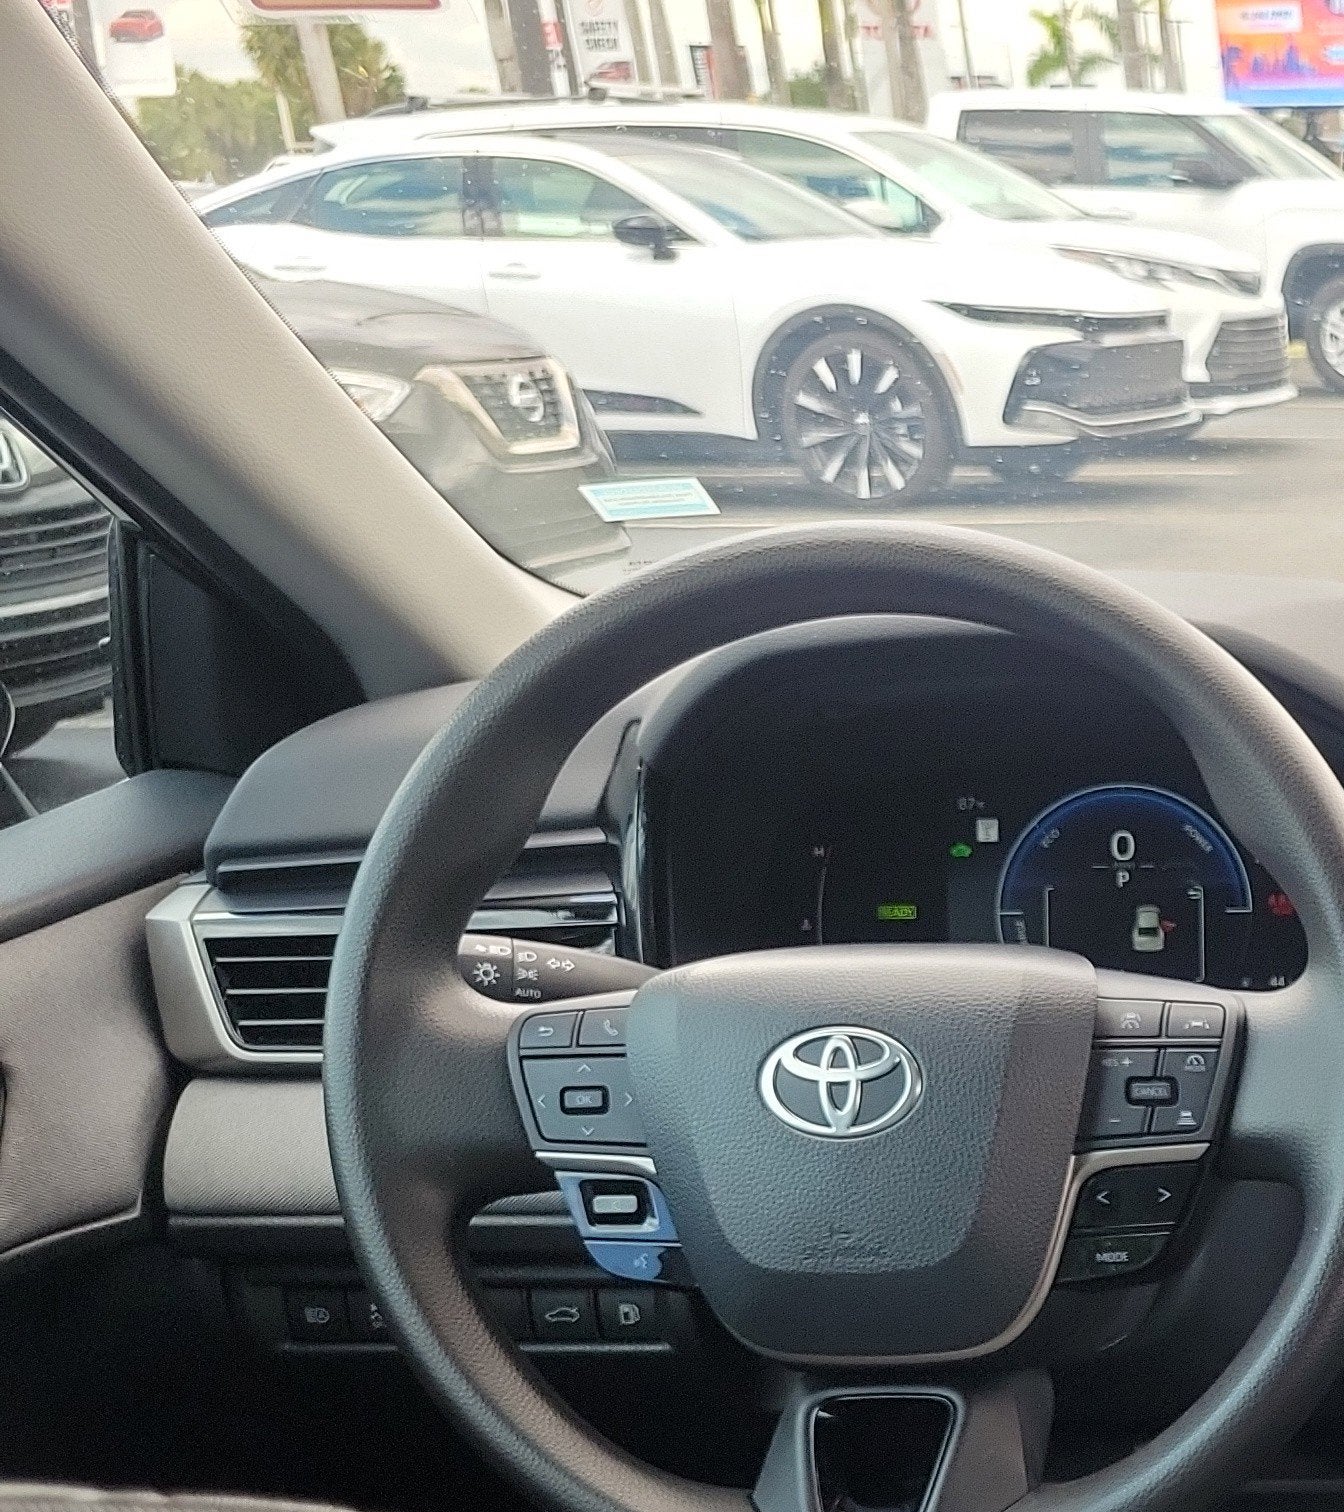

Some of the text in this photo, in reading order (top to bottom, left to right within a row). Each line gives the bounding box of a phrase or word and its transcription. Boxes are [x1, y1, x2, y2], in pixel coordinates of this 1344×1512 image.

[1115, 868, 1131, 889] P
[514, 987, 542, 999] AUTO
[577, 1094, 593, 1105] OK
[1095, 1251, 1129, 1263] MODE
